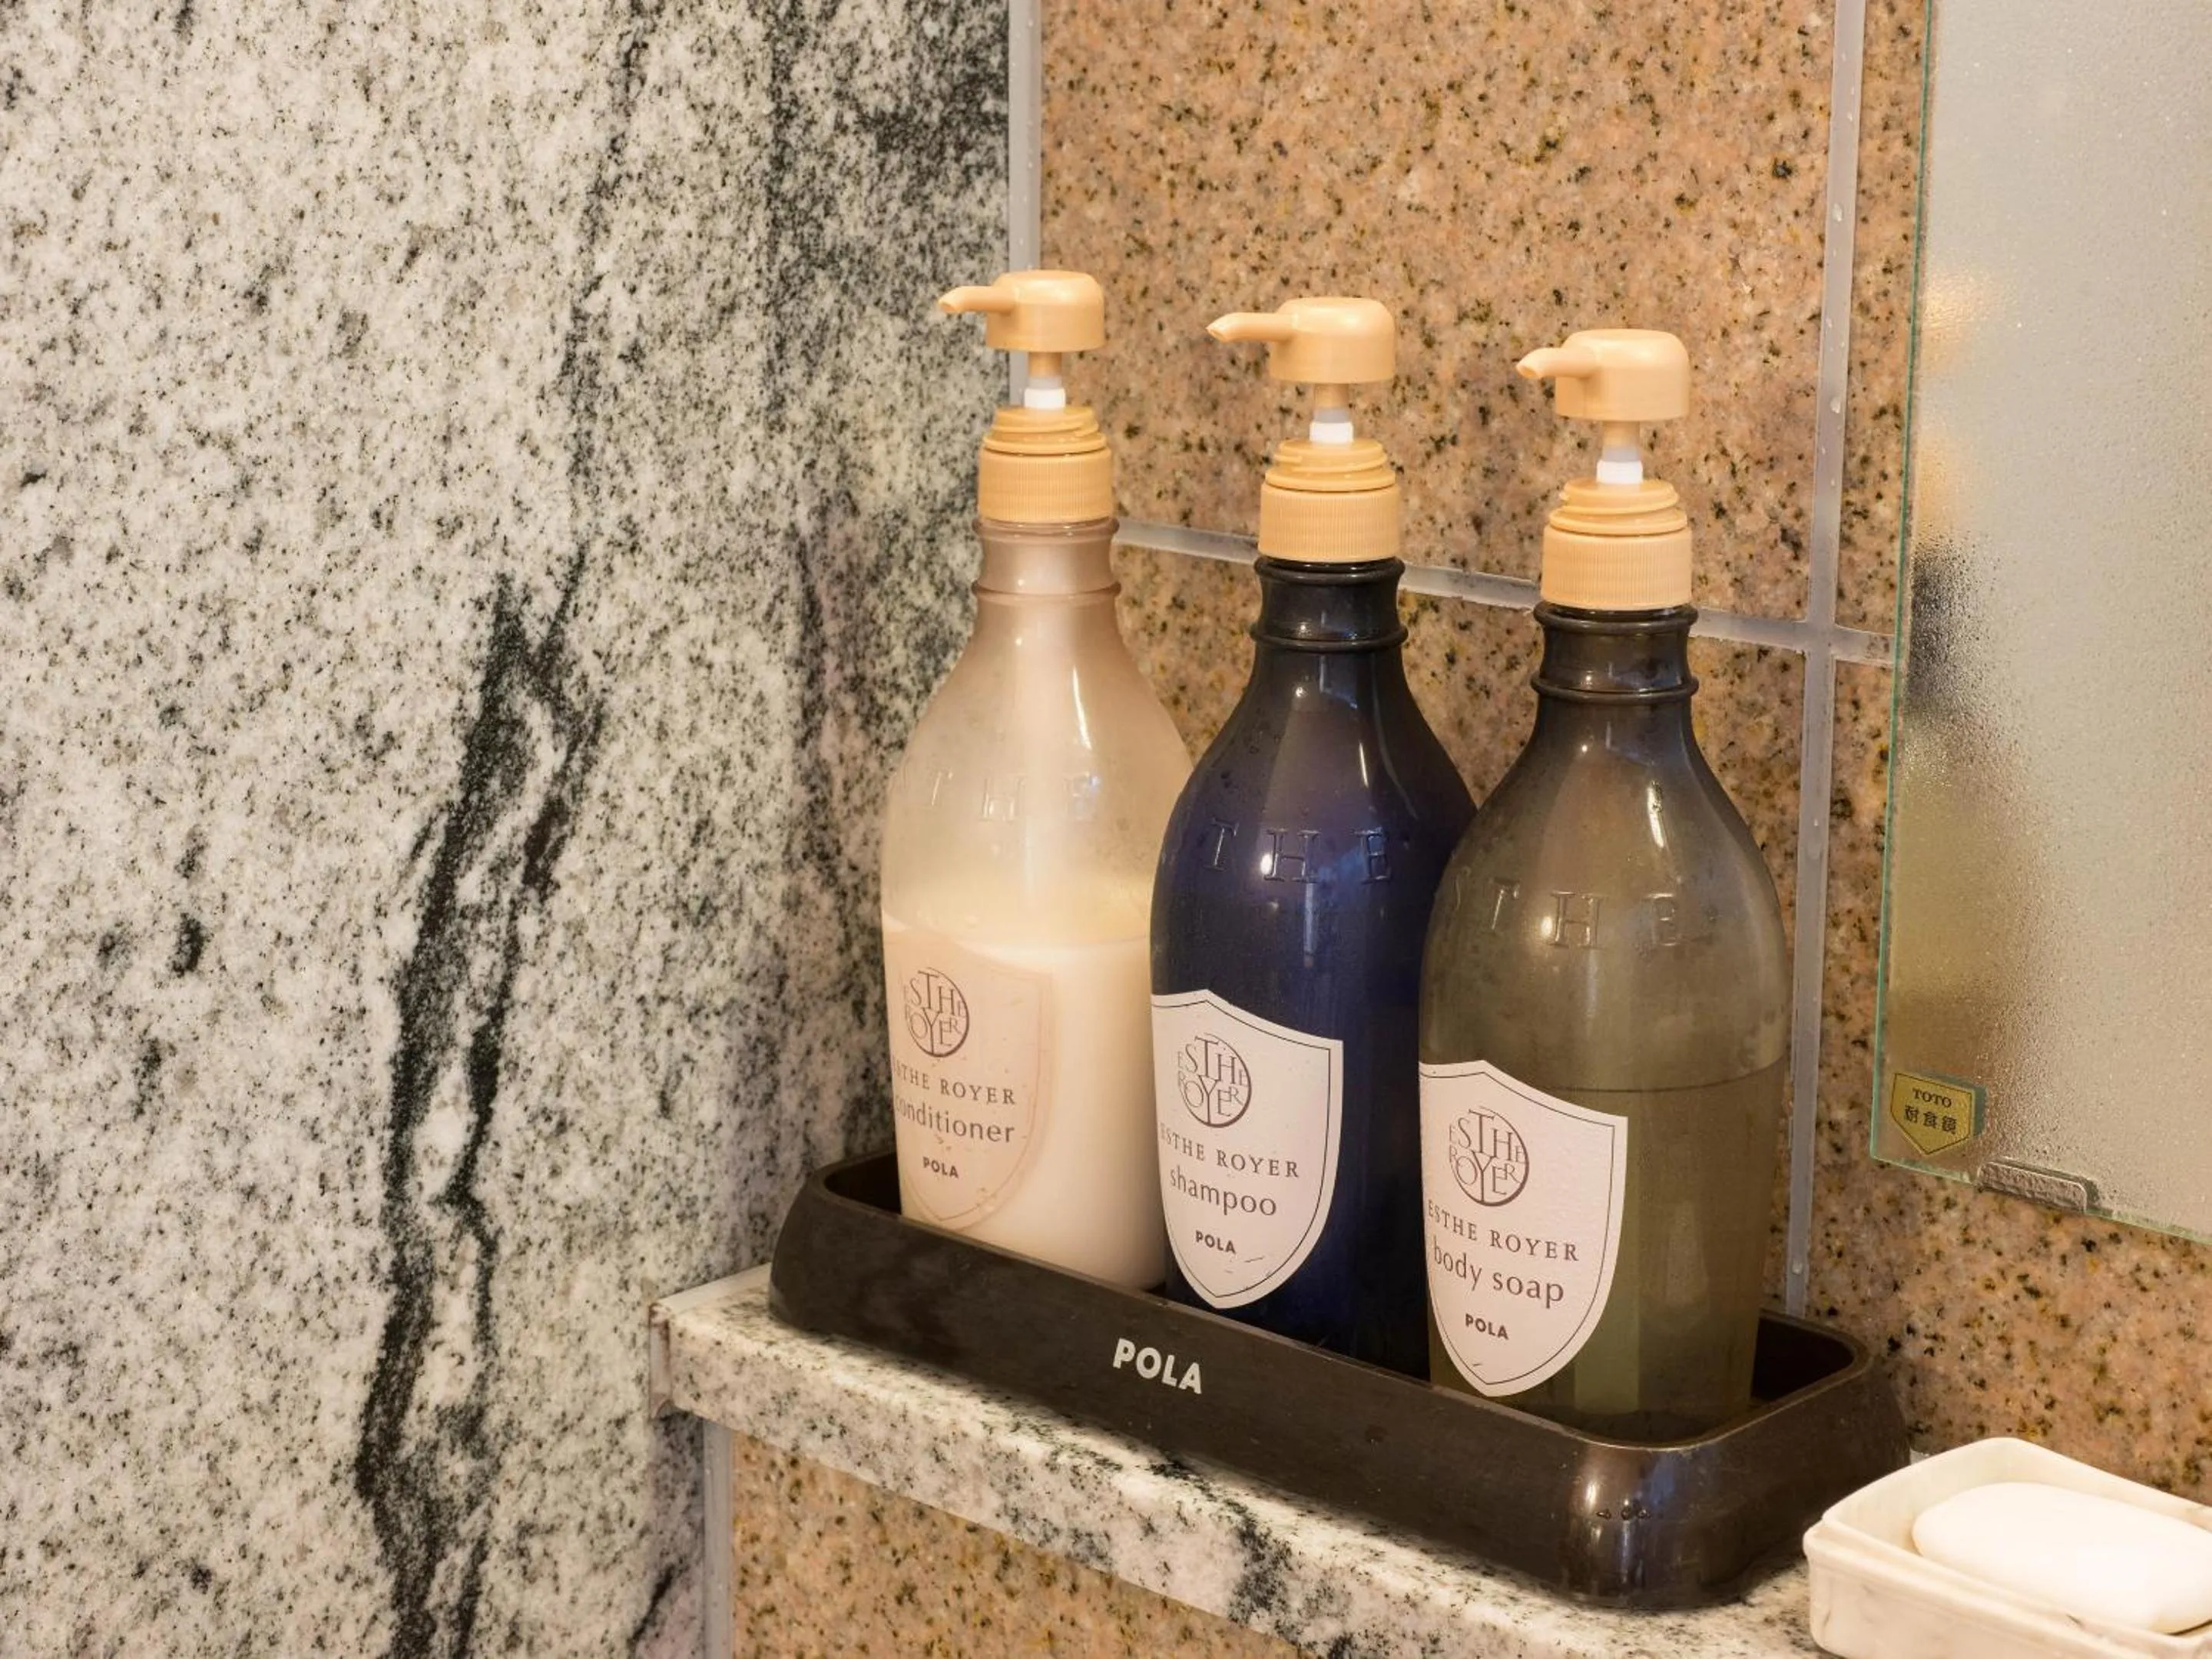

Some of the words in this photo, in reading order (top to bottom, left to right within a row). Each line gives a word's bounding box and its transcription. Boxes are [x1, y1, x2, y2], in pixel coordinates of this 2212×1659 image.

[939, 1078, 1015, 1105] ROYER
[1912, 1088, 1952, 1108] TOTO
[922, 1155, 959, 1179] POLA
[1216, 1149, 1300, 1178] ROYER
[1170, 1164, 1277, 1216] shampoo
[1195, 1230, 1237, 1255] POLA
[1428, 1199, 1478, 1242] ESTHE
[1489, 1229, 1580, 1262] ROYER
[1433, 1234, 1483, 1292] body
[1492, 1271, 1565, 1310] soap
[1465, 1313, 1510, 1340] POLA
[1112, 1337, 1203, 1395] POLA
